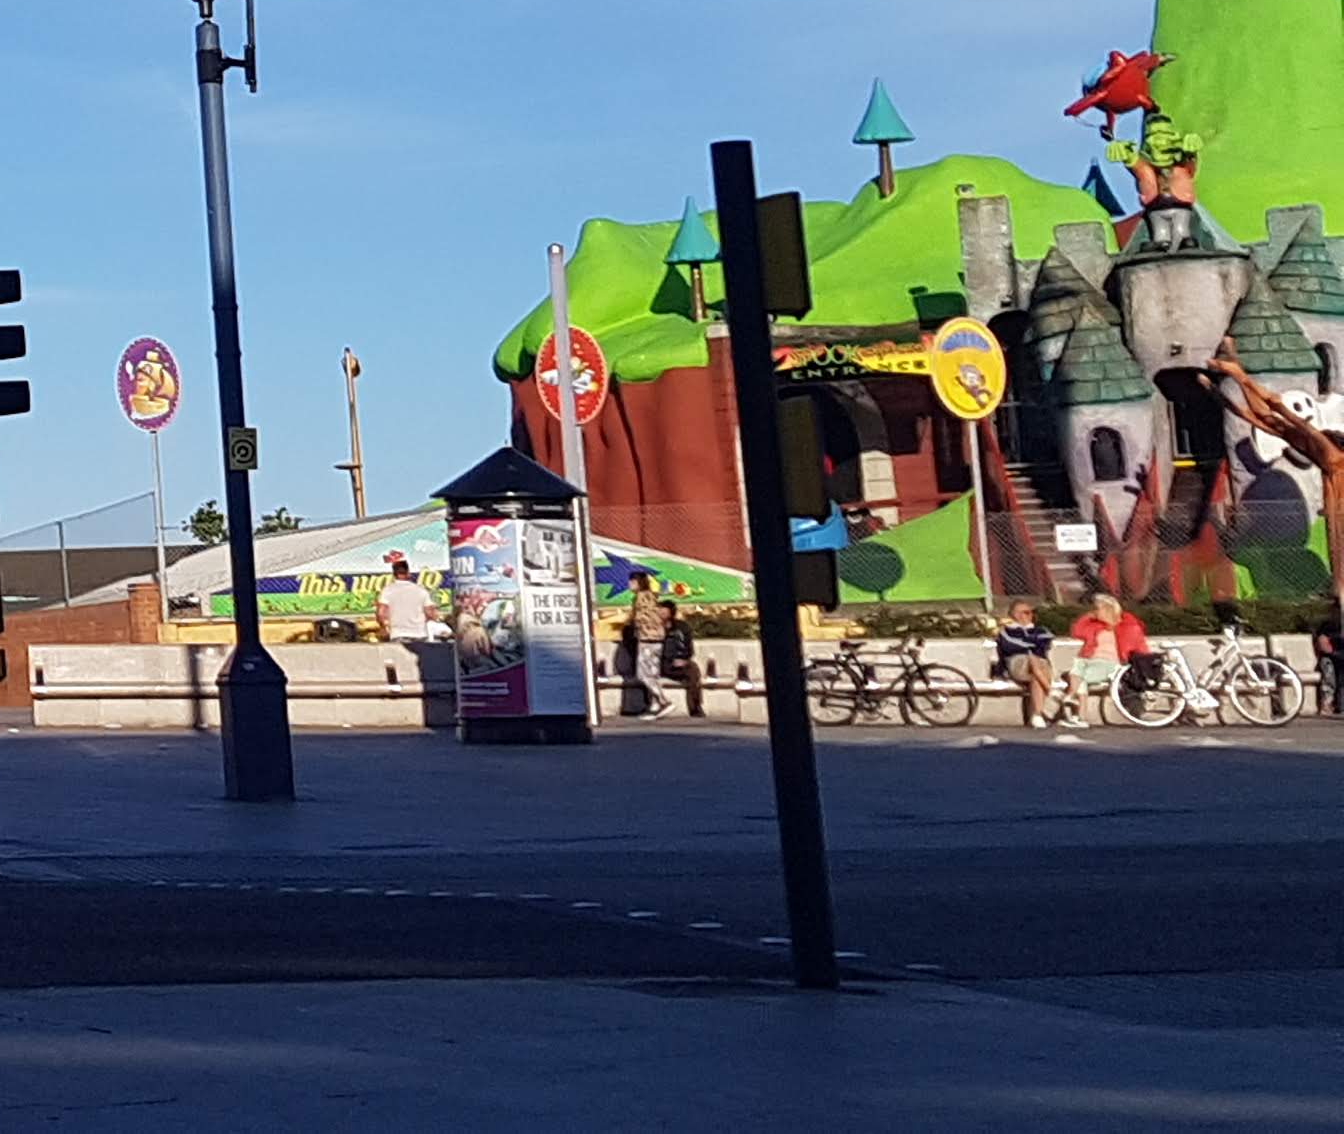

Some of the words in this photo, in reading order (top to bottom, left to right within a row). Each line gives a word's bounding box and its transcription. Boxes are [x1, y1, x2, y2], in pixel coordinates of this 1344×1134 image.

[791, 359, 927, 380] ENTRANCE
[296, 572, 346, 596] This
[533, 594, 550, 607] THE
[533, 611, 551, 625] FOR
